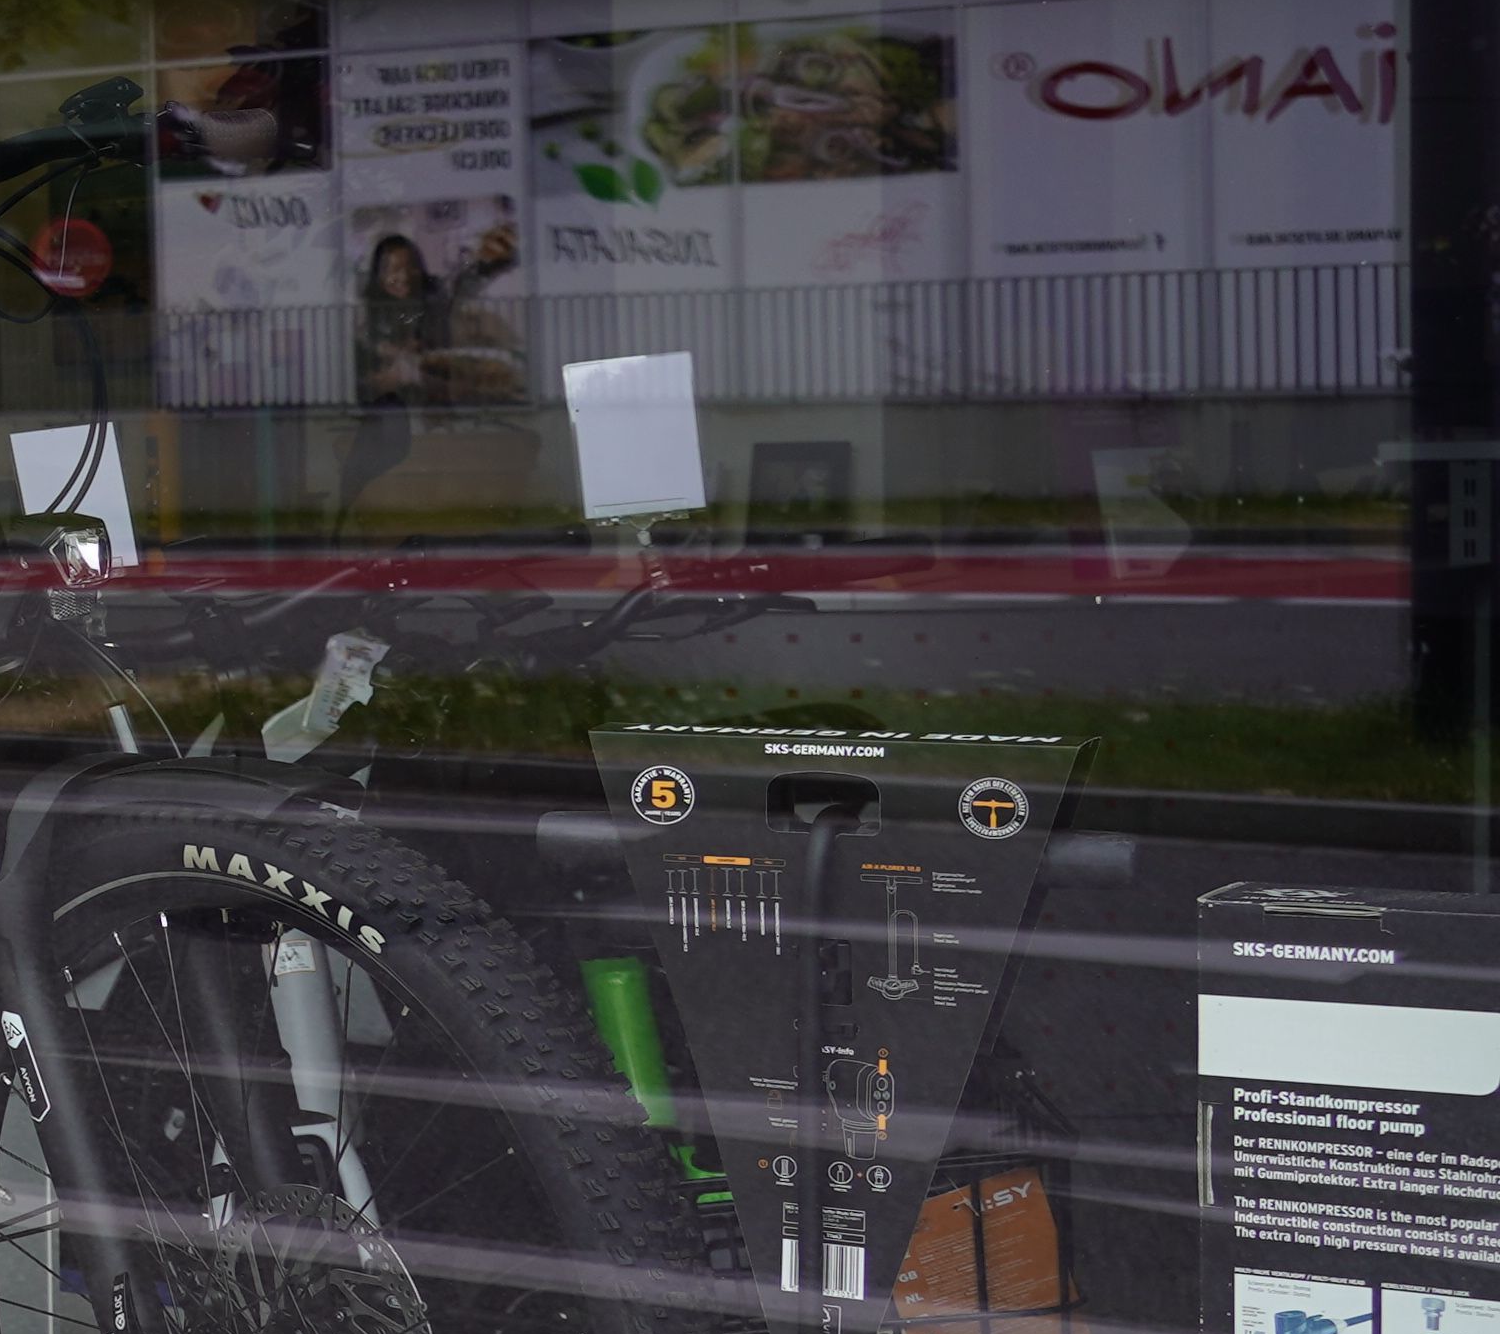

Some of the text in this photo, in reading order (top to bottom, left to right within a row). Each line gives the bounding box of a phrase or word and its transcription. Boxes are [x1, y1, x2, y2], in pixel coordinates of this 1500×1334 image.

[764, 743, 885, 758] SKS-GERMANY.COM
[651, 780, 677, 808] 5
[183, 843, 387, 955] MAXXIS
[1233, 941, 1395, 965] SKS-GERMANY.COM
[20, 1065, 38, 1105] AVYON
[1234, 1088, 1421, 1115] Profi-Standkompressor
[1234, 1106, 1425, 1137] Professional floor pump
[1234, 1135, 1256, 1148] Der
[1258, 1138, 1373, 1158] RENNKOMPRESSOR
[1386, 1149, 1413, 1162] eine
[1416, 1151, 1438, 1164] der
[1441, 1154, 1457, 1166] im
[1234, 1150, 1326, 1169] Unverwüstliche
[1329, 1159, 1410, 1177] Konstruktion
[1413, 1169, 1436, 1179] aus
[1234, 1167, 1255, 1179] mit
[1257, 1169, 1360, 1189] Gummiprotektor.
[1363, 1178, 1397, 1192] Extra
[1400, 1181, 1440, 1197] langer
[1234, 1196, 1499, 1231] The RENNKOMPRESSOR is the most popular
[1234, 1211, 1320, 1230] Indestructible
[1322, 1222, 1401, 1237] construction
[1405, 1229, 1457, 1243] consists
[1461, 1233, 1474, 1244] of
[1234, 1226, 1256, 1239] The
[1259, 1229, 1292, 1242] extra
[1294, 1232, 1321, 1248] long
[1323, 1235, 1350, 1250] high
[1353, 1240, 1407, 1254] pressure
[1410, 1243, 1440, 1257] hose
[1443, 1247, 1455, 1259] is
